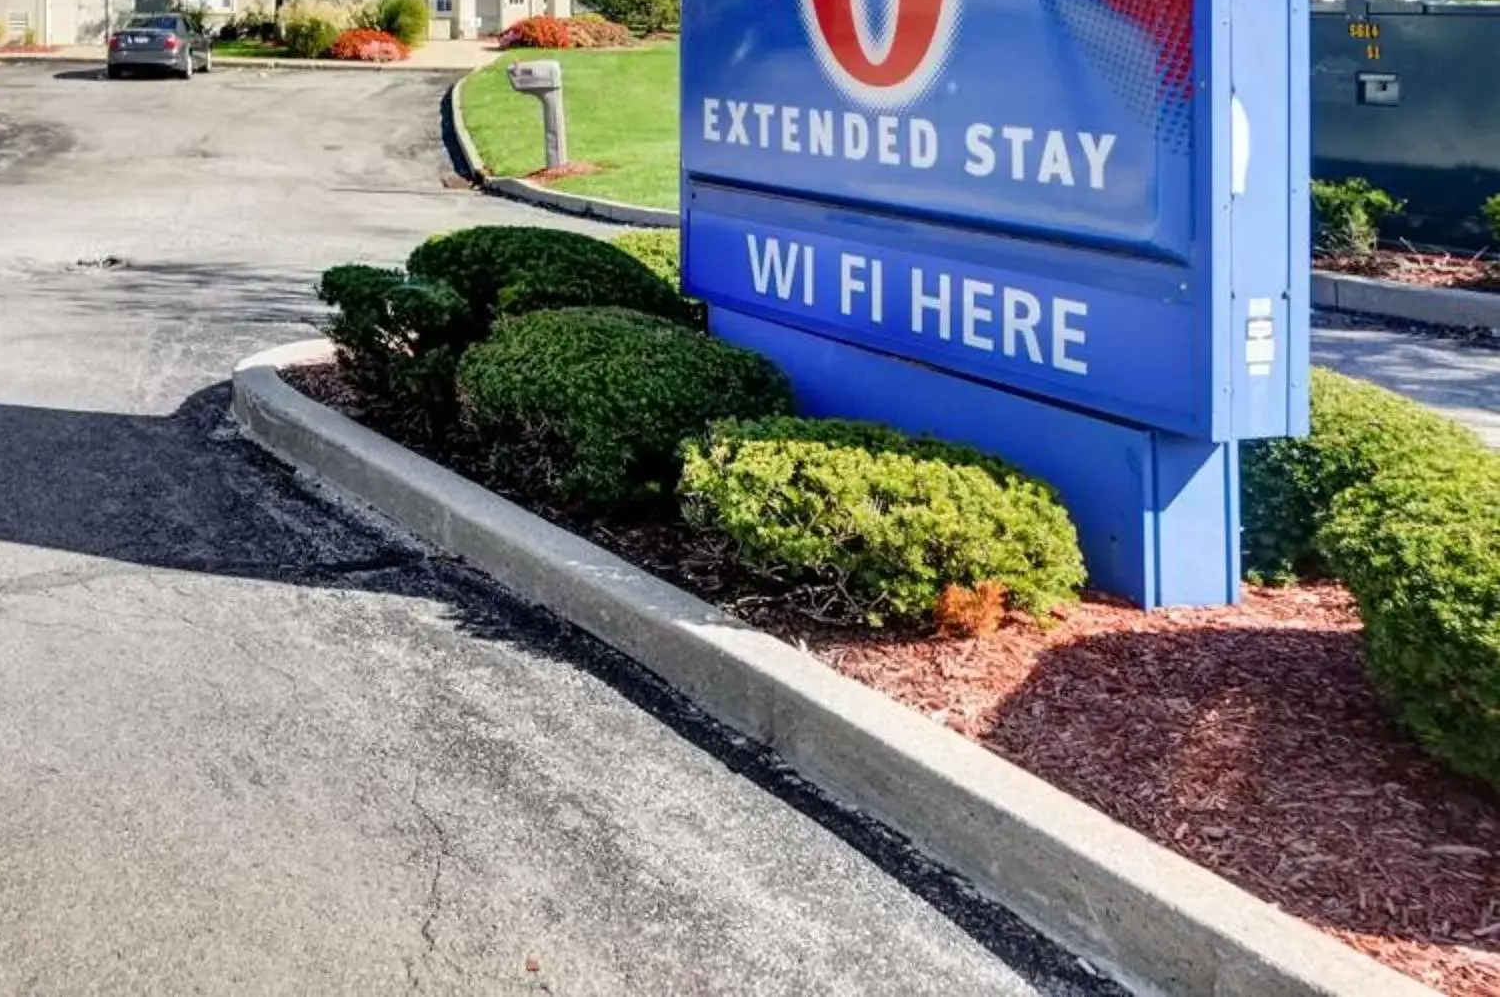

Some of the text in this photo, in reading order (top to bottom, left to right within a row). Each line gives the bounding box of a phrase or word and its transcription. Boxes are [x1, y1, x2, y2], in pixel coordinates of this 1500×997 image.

[703, 98, 1118, 190] EXTENDED STAY
[746, 233, 1089, 377] WI FI HERE
